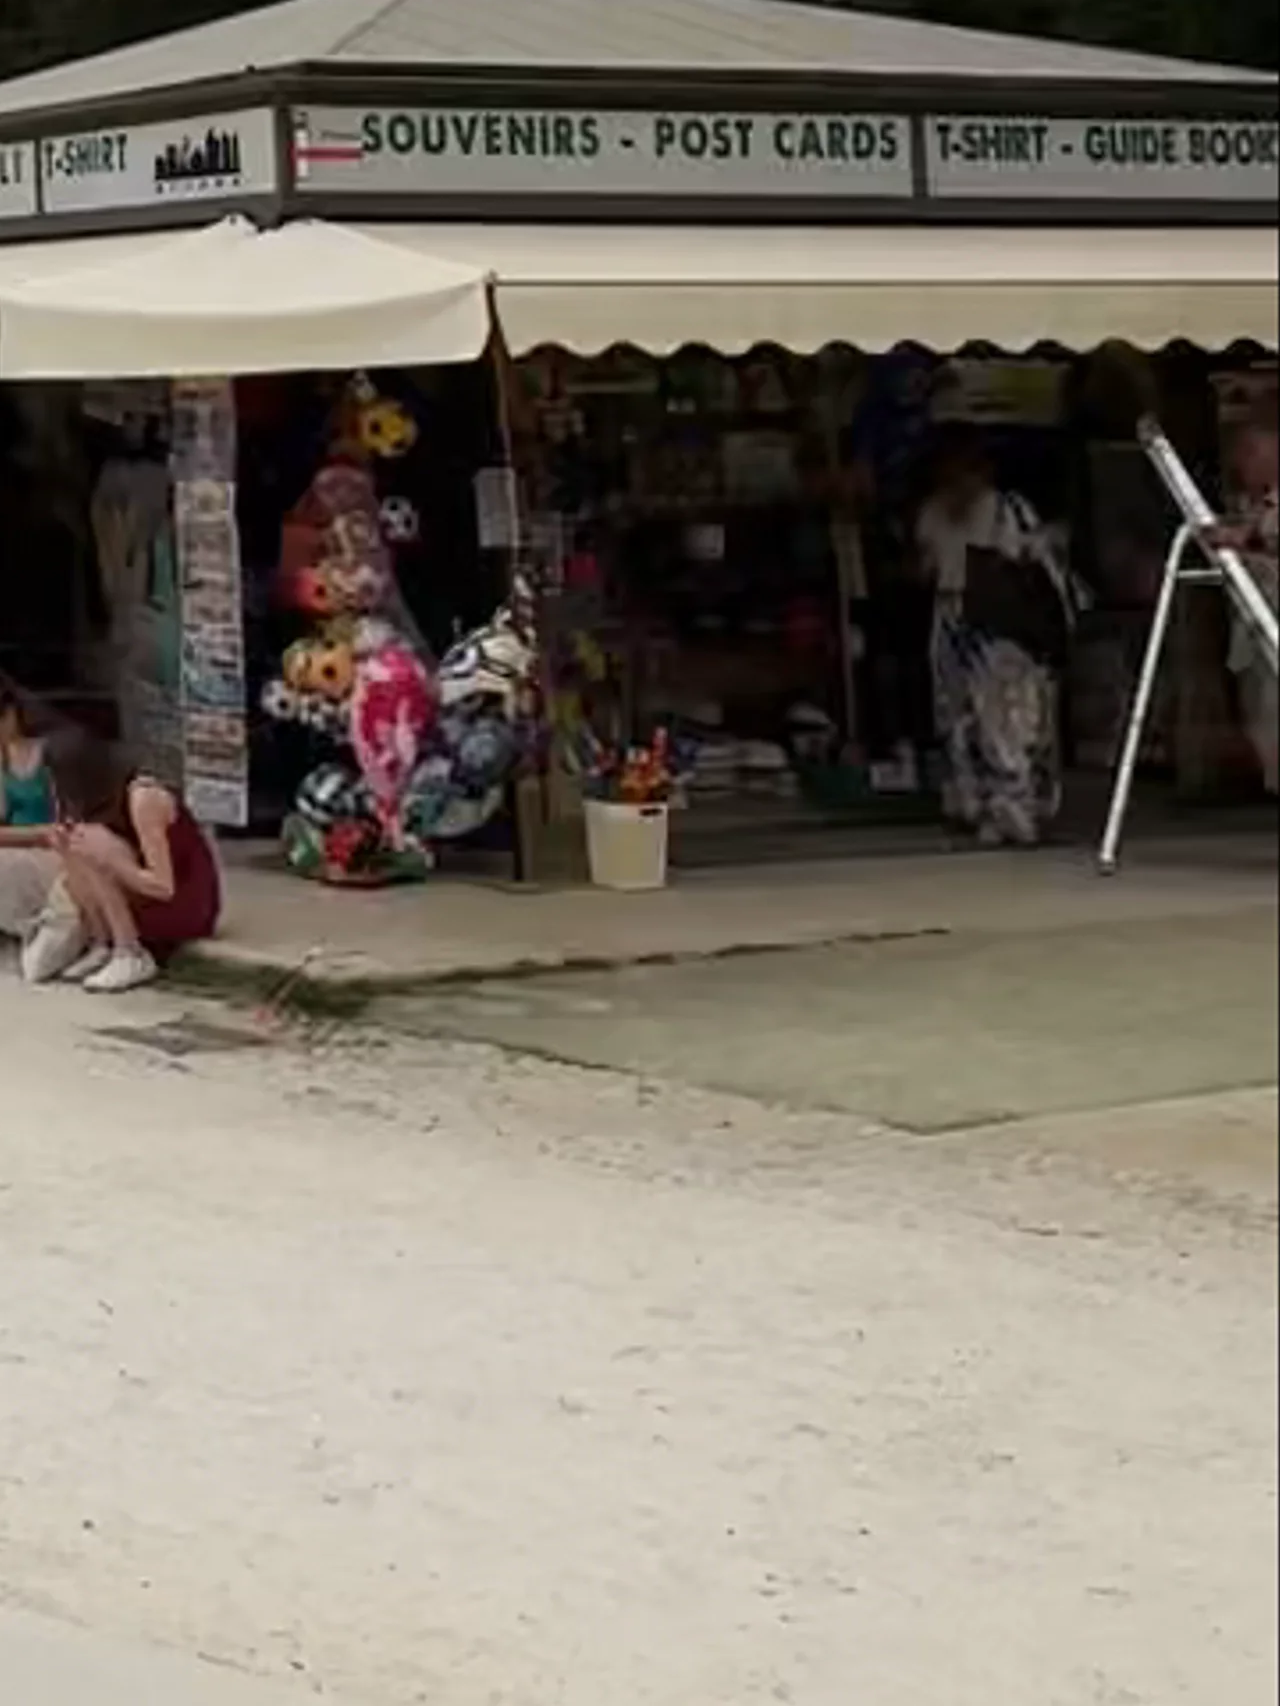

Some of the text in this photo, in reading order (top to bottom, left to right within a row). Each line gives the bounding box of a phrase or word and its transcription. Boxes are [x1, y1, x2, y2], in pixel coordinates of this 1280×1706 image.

[362, 112, 599, 157] SOUVENIRS
[655, 118, 753, 159] POST
[773, 120, 897, 160] CARDS
[937, 123, 1048, 162] T-SHIRT
[1084, 125, 1181, 163] GUIDE
